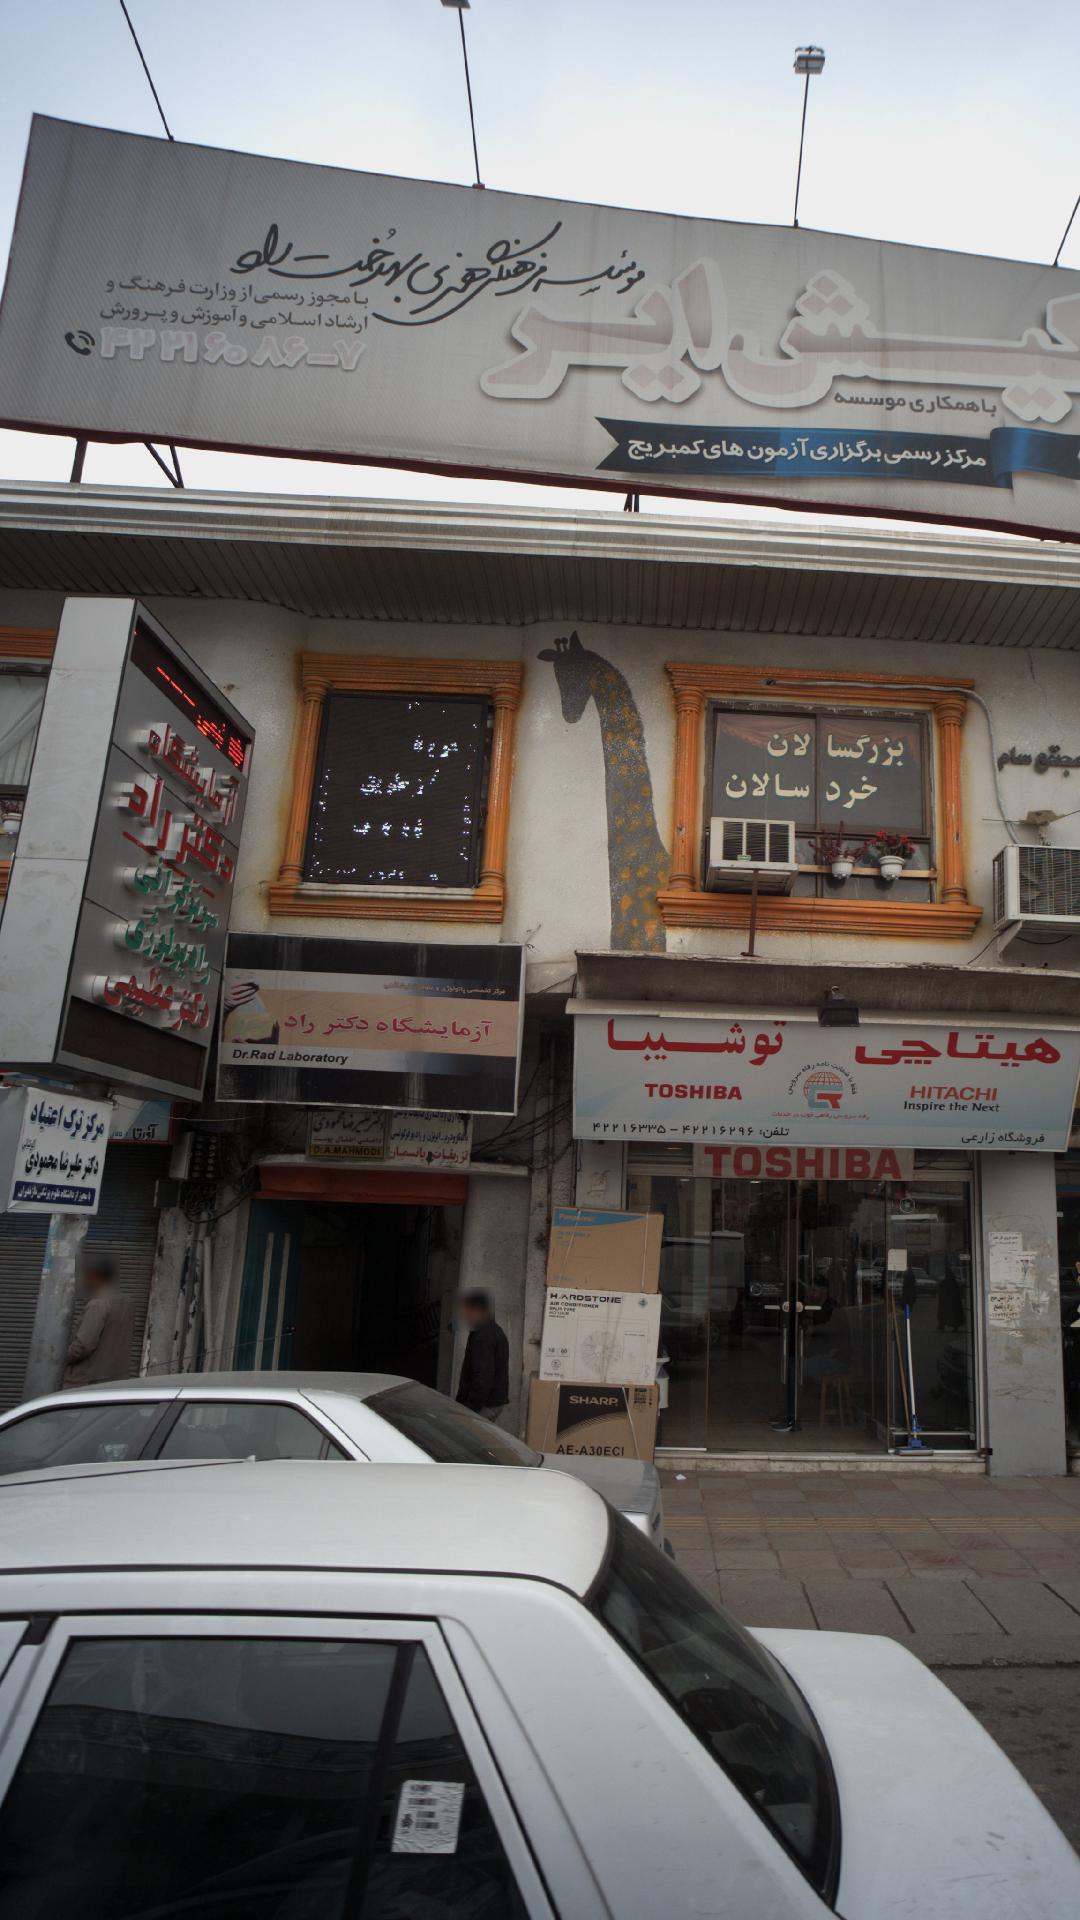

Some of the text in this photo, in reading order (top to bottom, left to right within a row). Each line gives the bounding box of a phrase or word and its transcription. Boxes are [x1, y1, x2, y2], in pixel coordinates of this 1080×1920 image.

[105, 279, 115, 293] و
[118, 275, 187, 297] فرهنگ
[189, 281, 237, 301] وزارت
[238, 284, 253, 302] از
[253, 291, 305, 306] رسمی
[306, 291, 352, 307] مجوز
[99, 302, 167, 322] پرورش
[180, 305, 238, 326] آموزش
[249, 311, 322, 329] اسلامی
[323, 314, 368, 334] ارشاد
[834, 391, 907, 411] موسسه
[626, 436, 988, 468] مرکز رسمی برگزاری آزمون های کمبریج
[724, 772, 810, 798] سالان
[283, 1013, 494, 1043] آزمایشگاه دکتر راد
[232, 1048, 349, 1065] Dr.Rad Laboratory
[854, 1031, 1062, 1068] هیتاچی
[644, 1083, 743, 1100] TOSHIBA
[909, 1085, 999, 1101] HITACHI
[30, 1100, 64, 1130] اعتیاد
[903, 1100, 1000, 1113] Inspire the Next
[961, 1131, 1046, 1146] فروشگاه زارعی
[24, 1151, 58, 1176] محمودی
[81, 1155, 99, 1180] دکتر
[703, 1145, 903, 1180] TOSHIBA
[568, 1395, 619, 1406] SHARP
